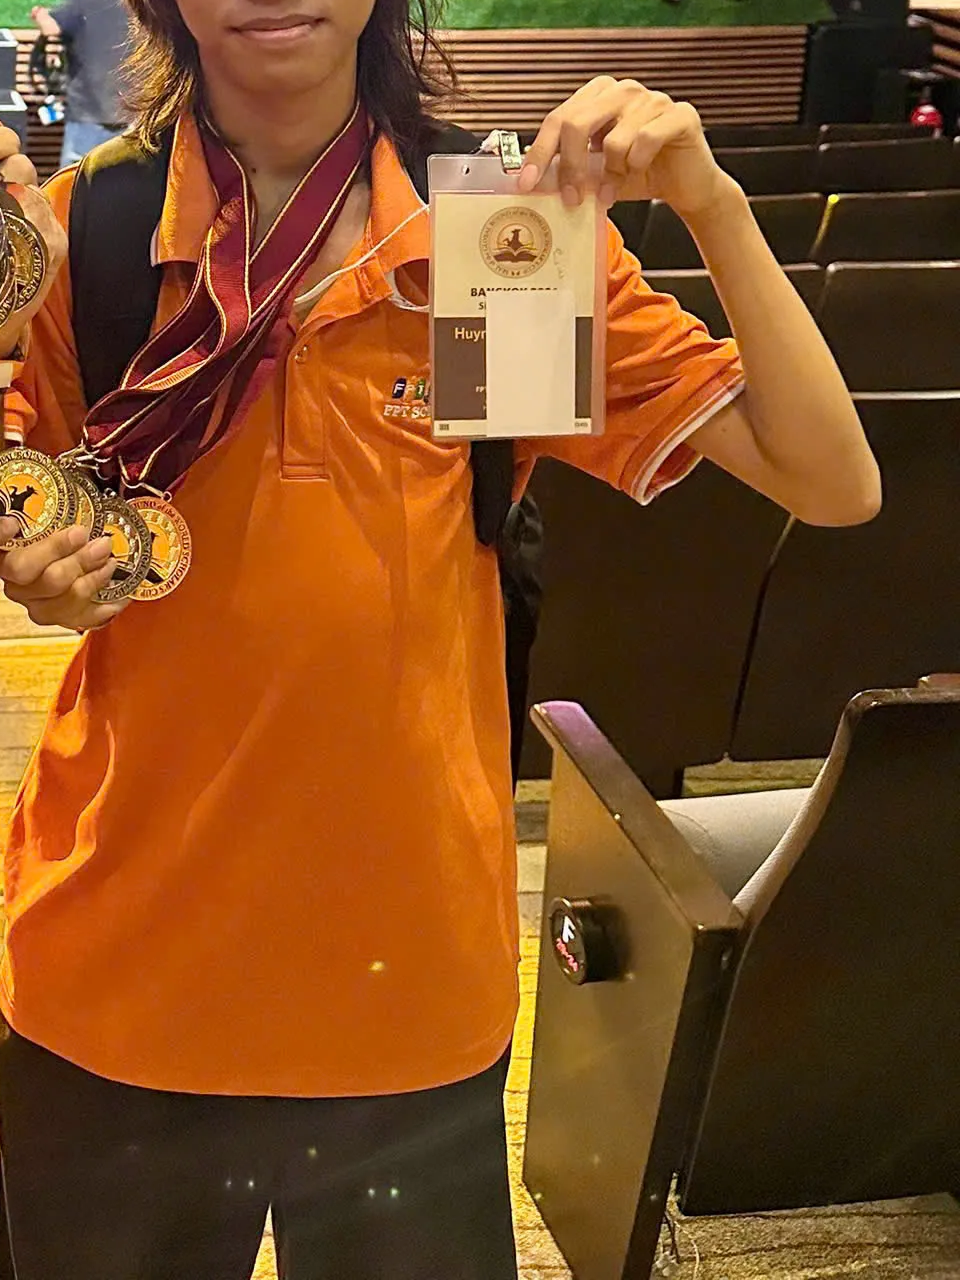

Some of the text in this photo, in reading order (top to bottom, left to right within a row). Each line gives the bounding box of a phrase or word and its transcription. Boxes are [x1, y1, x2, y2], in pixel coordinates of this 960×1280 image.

[175, 517, 189, 549] WORLD
[158, 551, 190, 595] SCHOLAR'S
[140, 589, 159, 598] CUP
